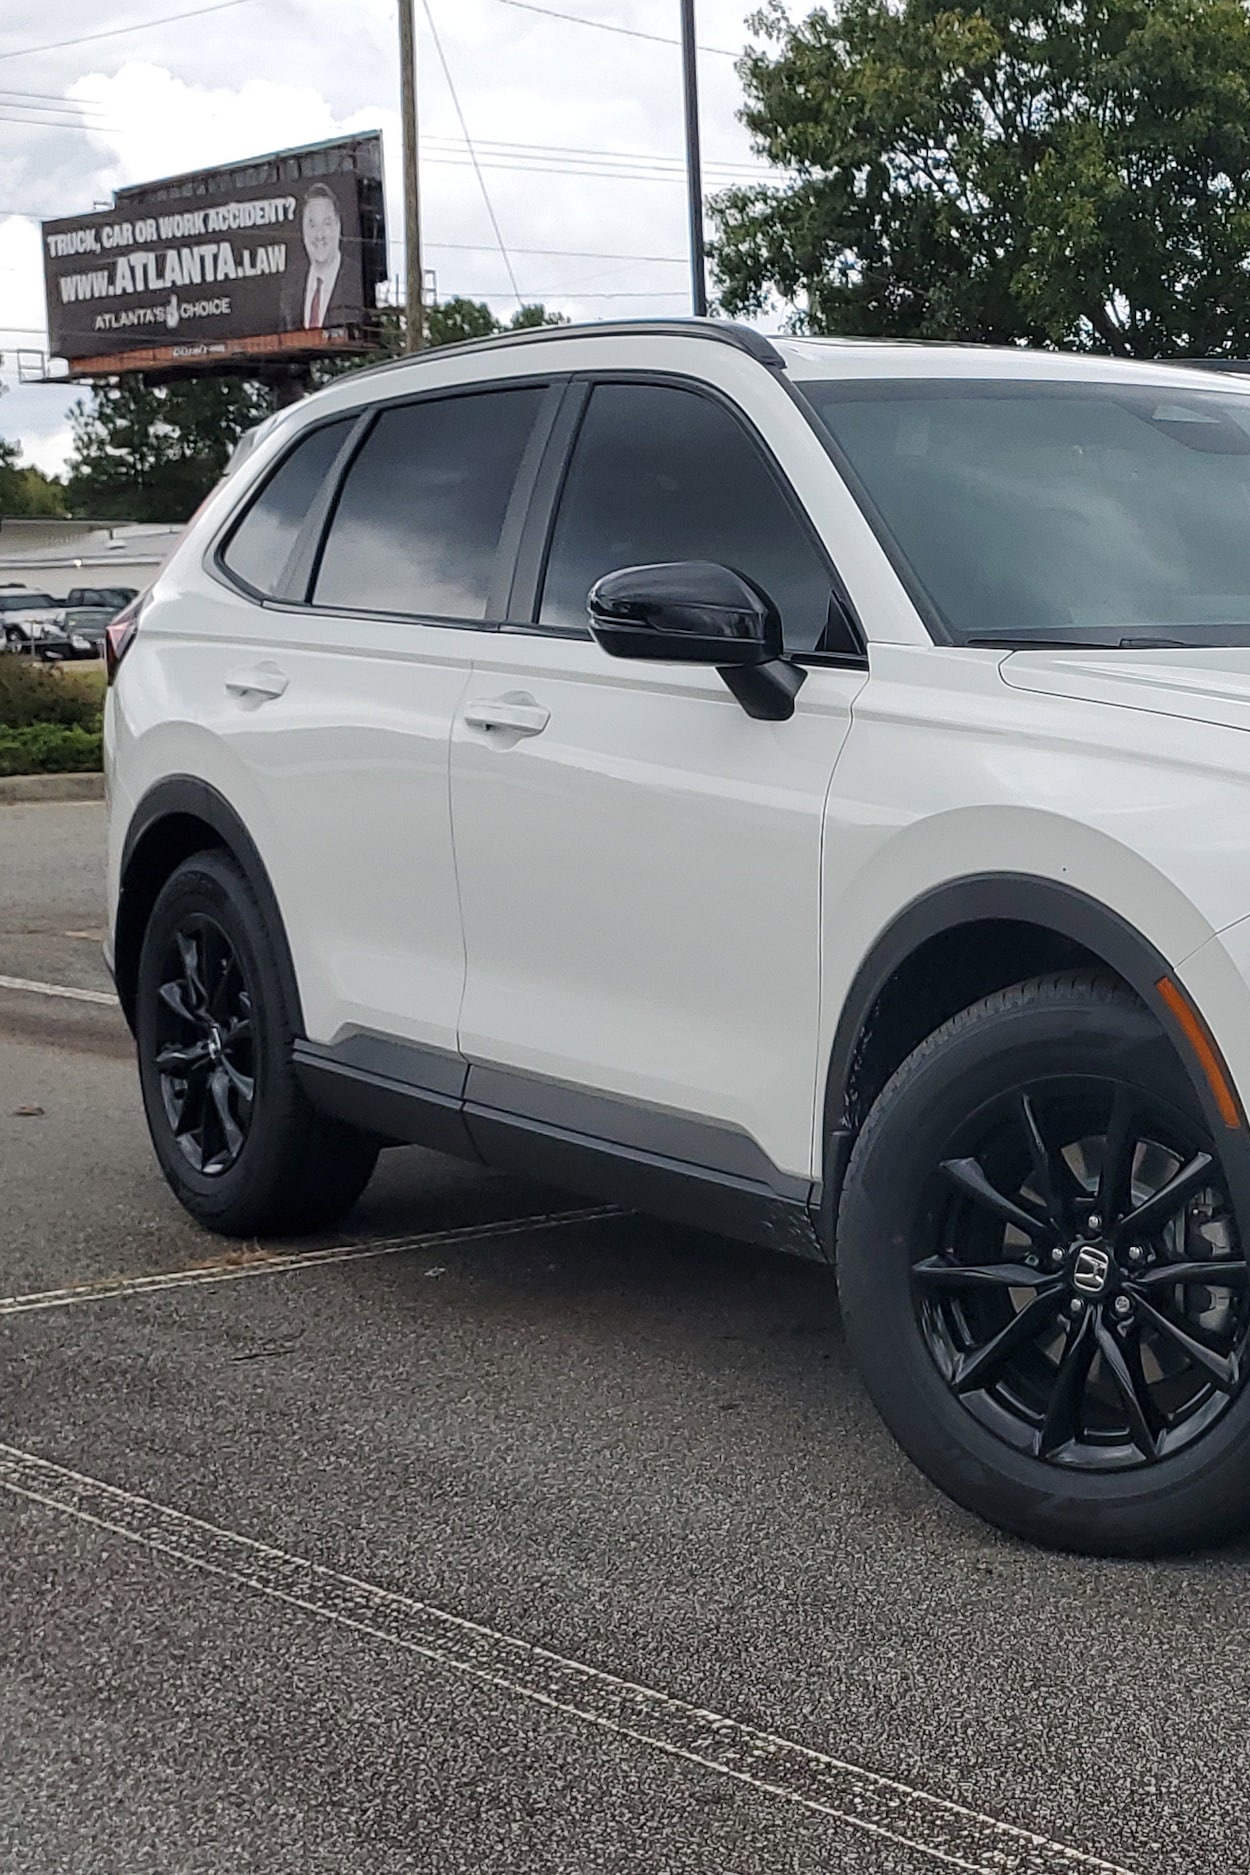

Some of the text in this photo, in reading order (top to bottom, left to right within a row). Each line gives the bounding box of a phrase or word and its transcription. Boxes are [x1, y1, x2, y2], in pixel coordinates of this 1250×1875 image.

[47, 196, 297, 258] TRUCK, CAR OR WORK ACCIDENT?
[94, 298, 232, 330] ATLANTA'S CHOICE
